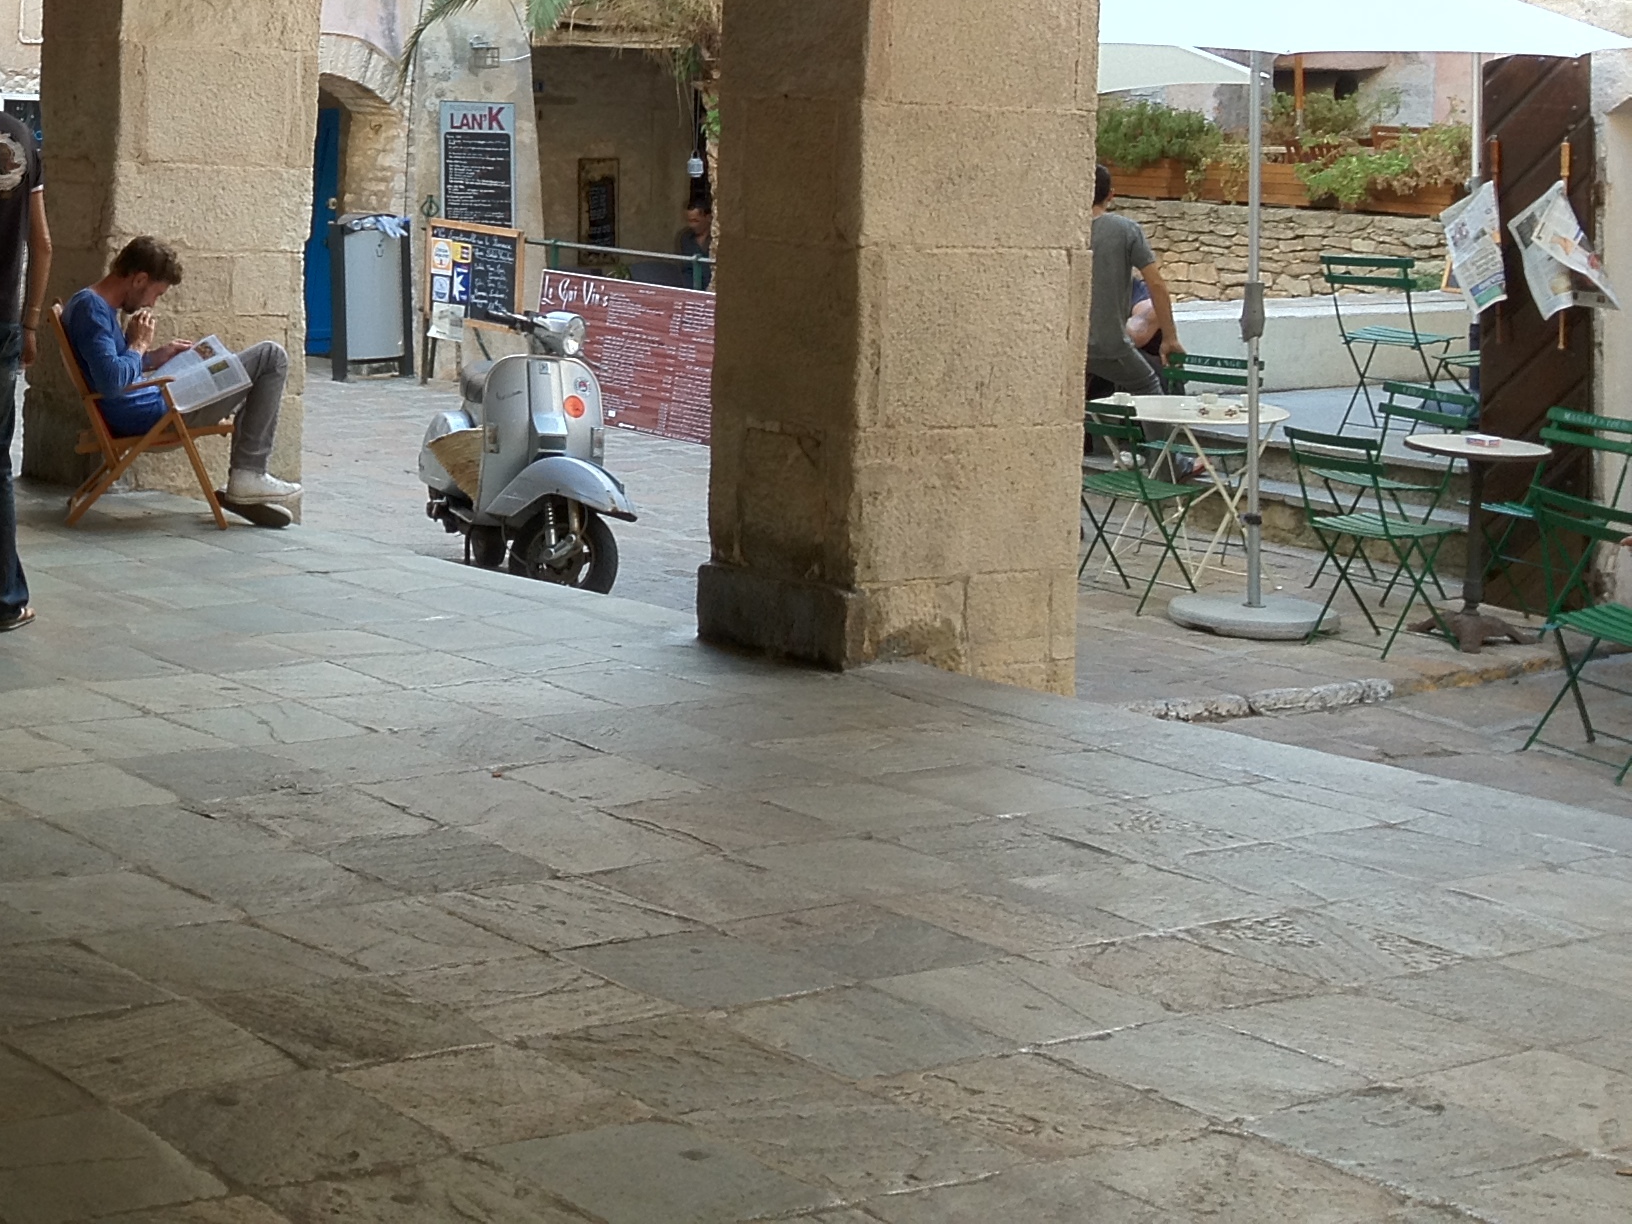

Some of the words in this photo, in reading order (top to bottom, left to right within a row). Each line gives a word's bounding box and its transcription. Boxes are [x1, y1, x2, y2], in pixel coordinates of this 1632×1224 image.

[450, 106, 506, 131] LAN'K
[541, 275, 556, 305] Le
[582, 280, 609, 308] Vin's
